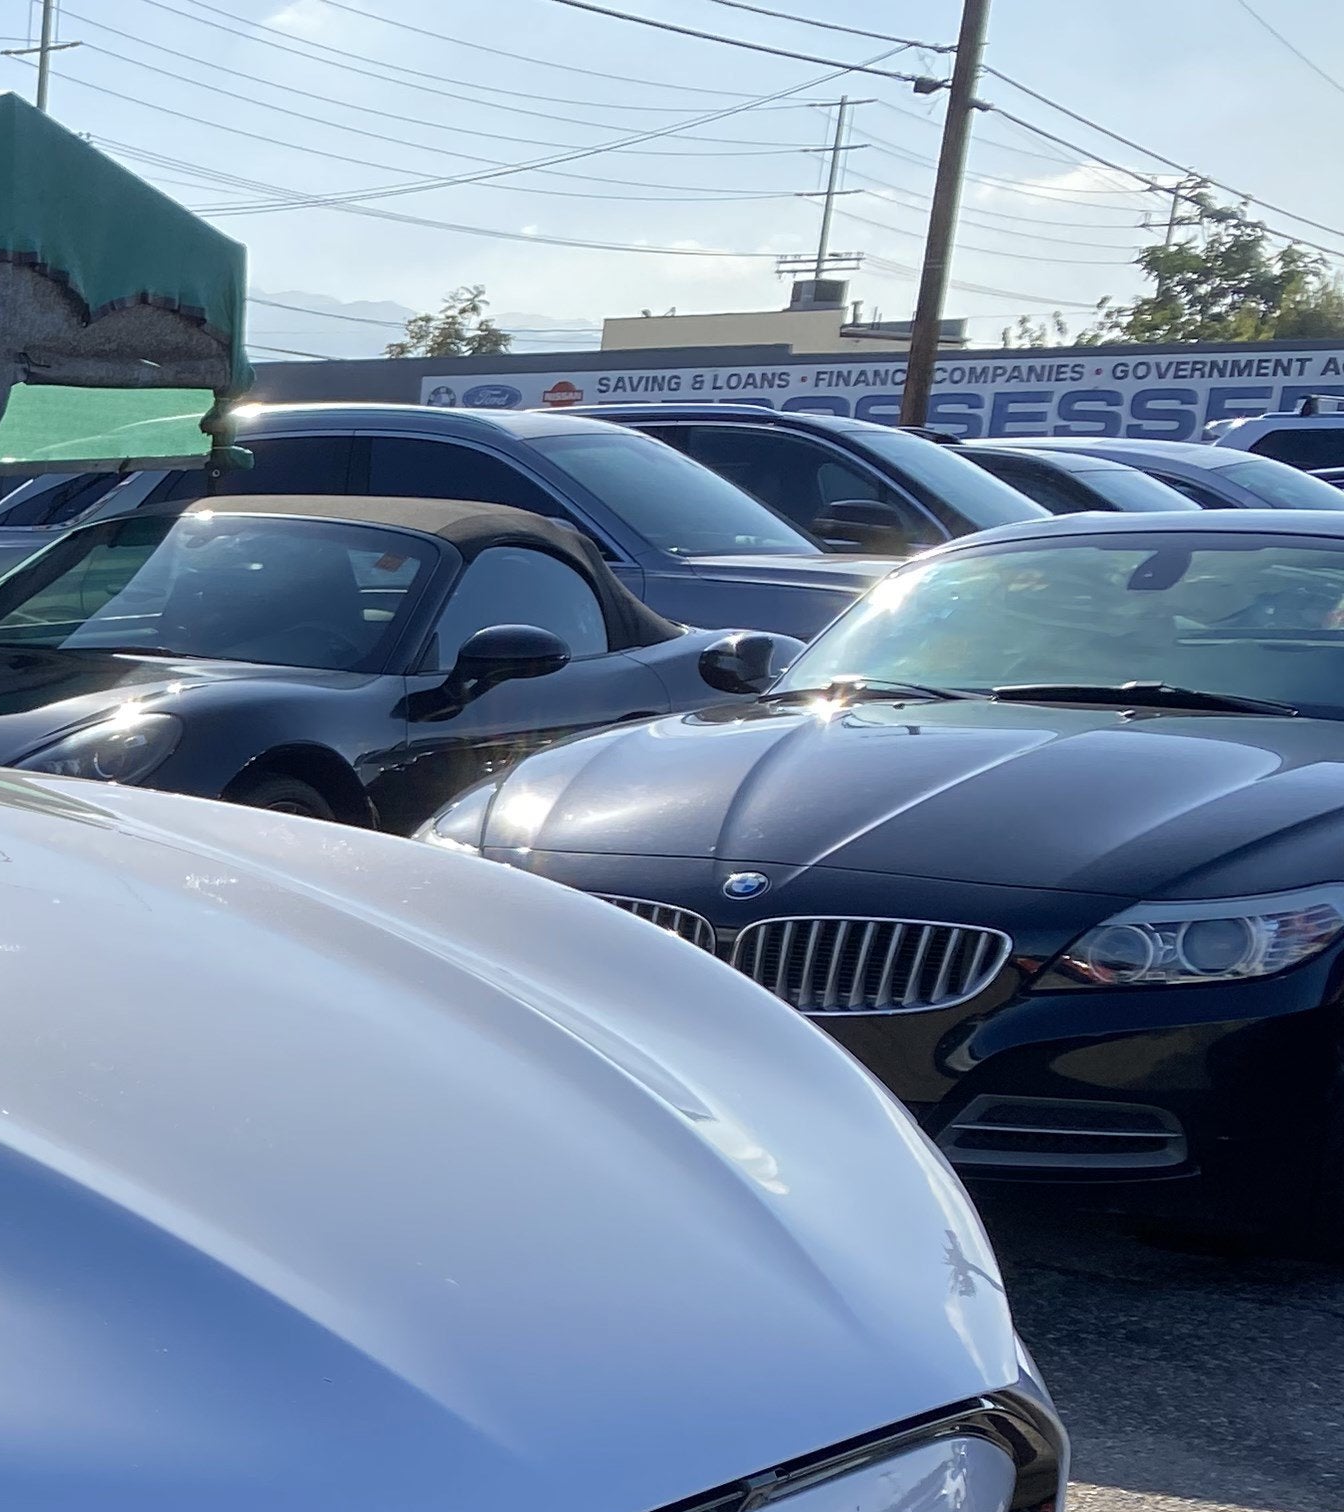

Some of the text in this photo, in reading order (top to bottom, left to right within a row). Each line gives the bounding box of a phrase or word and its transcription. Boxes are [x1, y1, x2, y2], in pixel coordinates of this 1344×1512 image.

[596, 356, 1344, 394] SAVING & LOANS FINANC COMPANIES GOVERNMENT A
[544, 391, 583, 402] NISSAN
